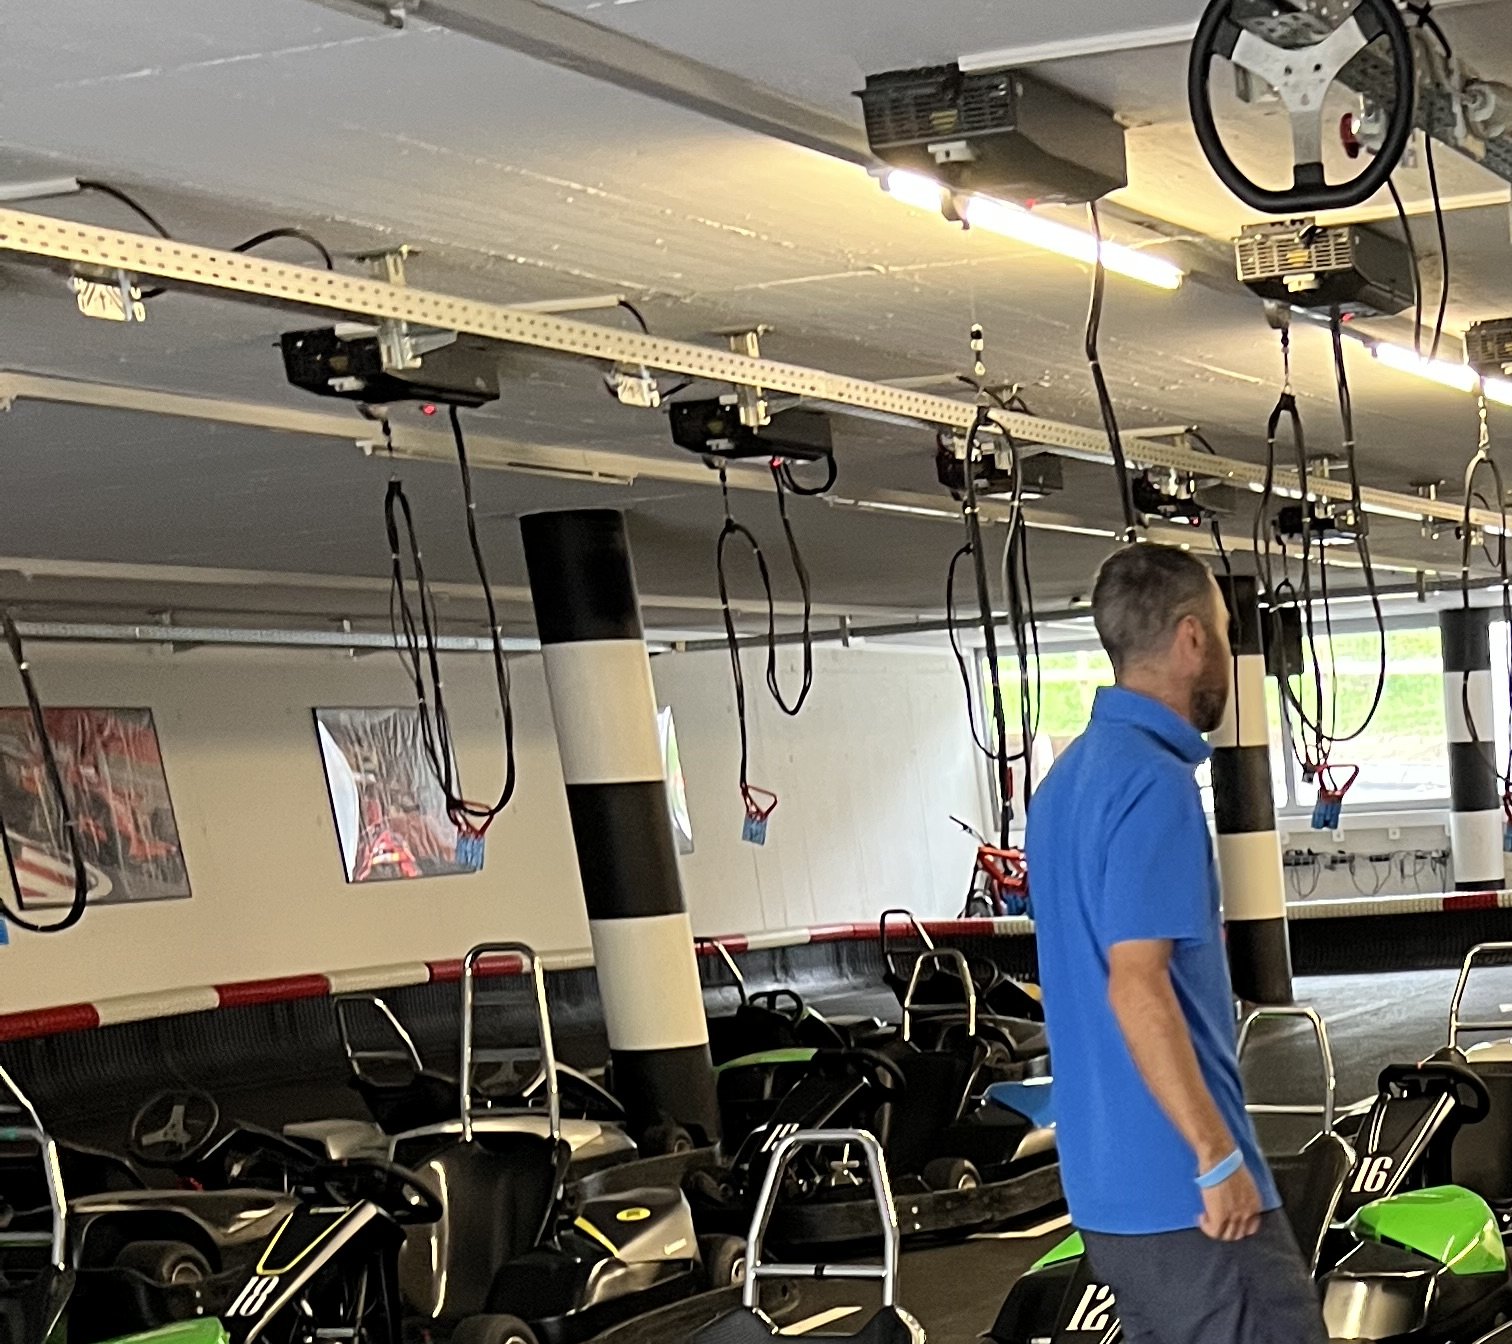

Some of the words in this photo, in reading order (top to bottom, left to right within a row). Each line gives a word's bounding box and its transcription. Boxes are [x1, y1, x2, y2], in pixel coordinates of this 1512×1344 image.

[1350, 1156, 1394, 1193] 16
[224, 1275, 280, 1318] 18
[1065, 1284, 1116, 1331] 12
